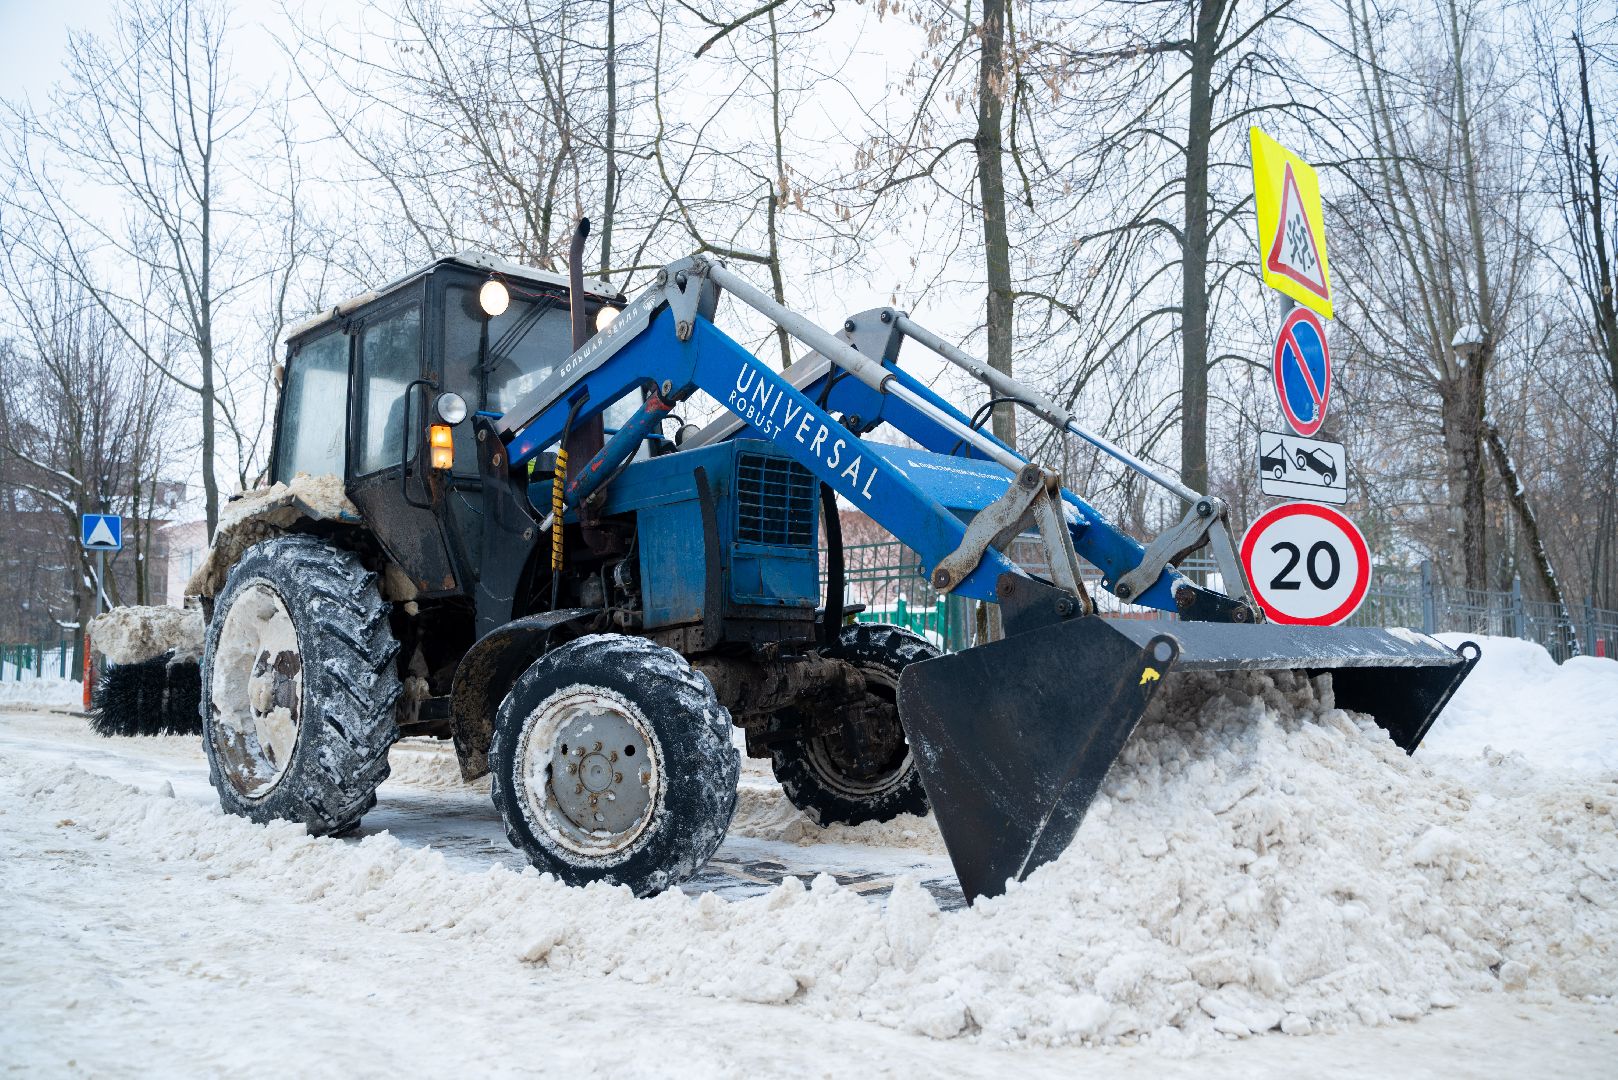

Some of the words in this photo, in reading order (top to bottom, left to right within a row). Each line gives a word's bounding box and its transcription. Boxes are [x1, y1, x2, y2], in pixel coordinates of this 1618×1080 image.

[560, 337, 603, 378] БОЛЬШАЯ
[607, 307, 638, 338] ЗЕМЛЯ
[728, 389, 782, 440] ROBUST
[736, 362, 878, 500] UNIVERSAL
[1269, 540, 1341, 591] 20
